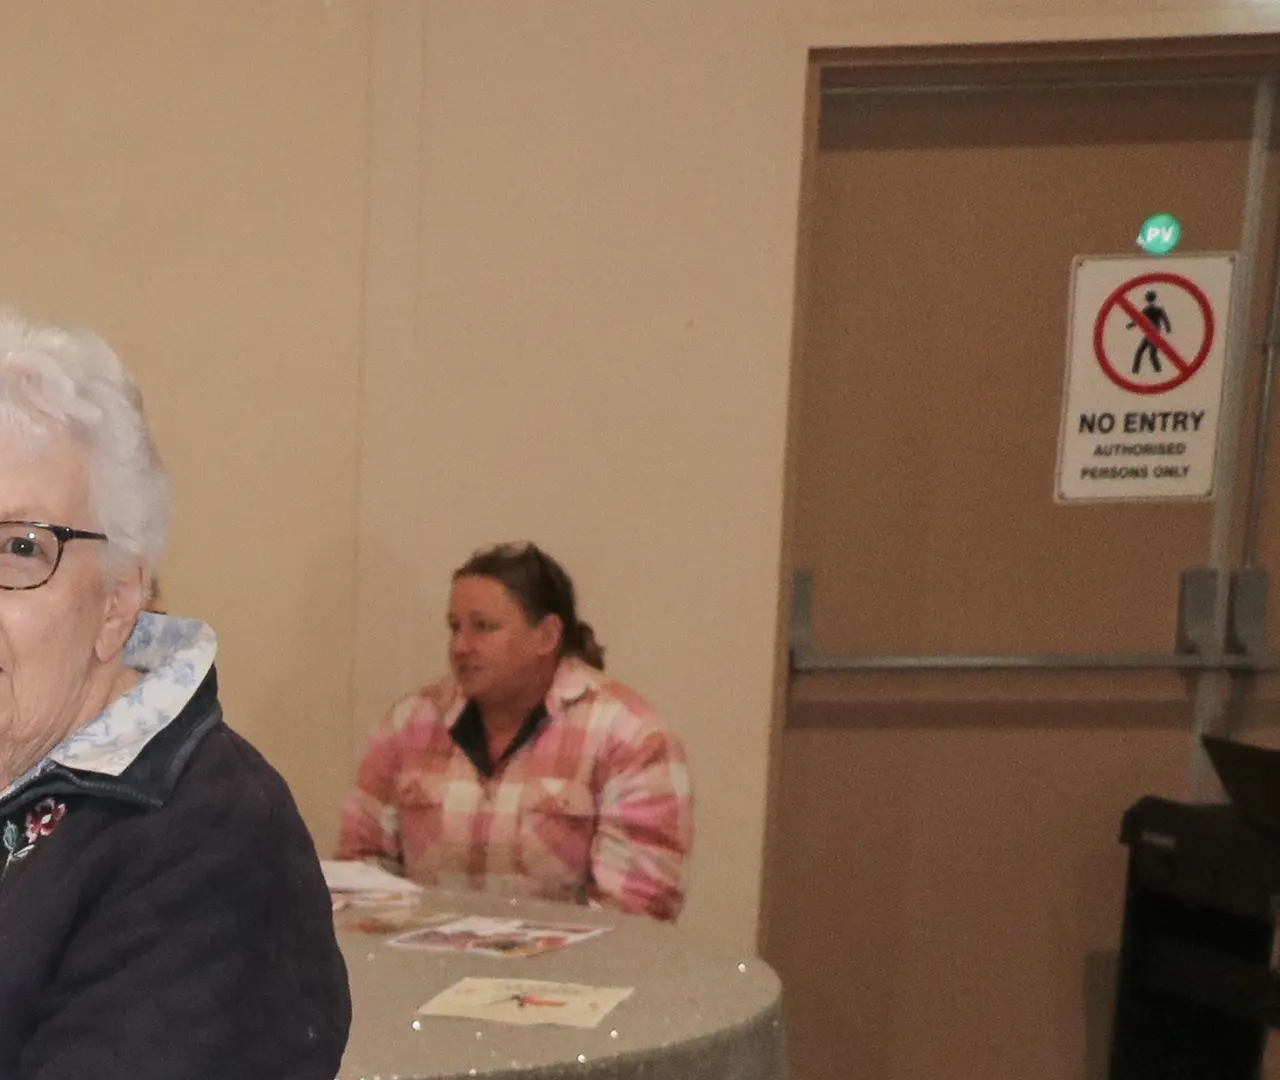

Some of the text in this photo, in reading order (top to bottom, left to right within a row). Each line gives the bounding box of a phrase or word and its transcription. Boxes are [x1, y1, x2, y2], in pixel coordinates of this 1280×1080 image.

[1146, 226, 1174, 243] PV
[1079, 410, 1204, 434] NO ENTRY
[1093, 442, 1186, 456] AUTHORISED
[1080, 465, 1190, 479] PERSONS ONLY
